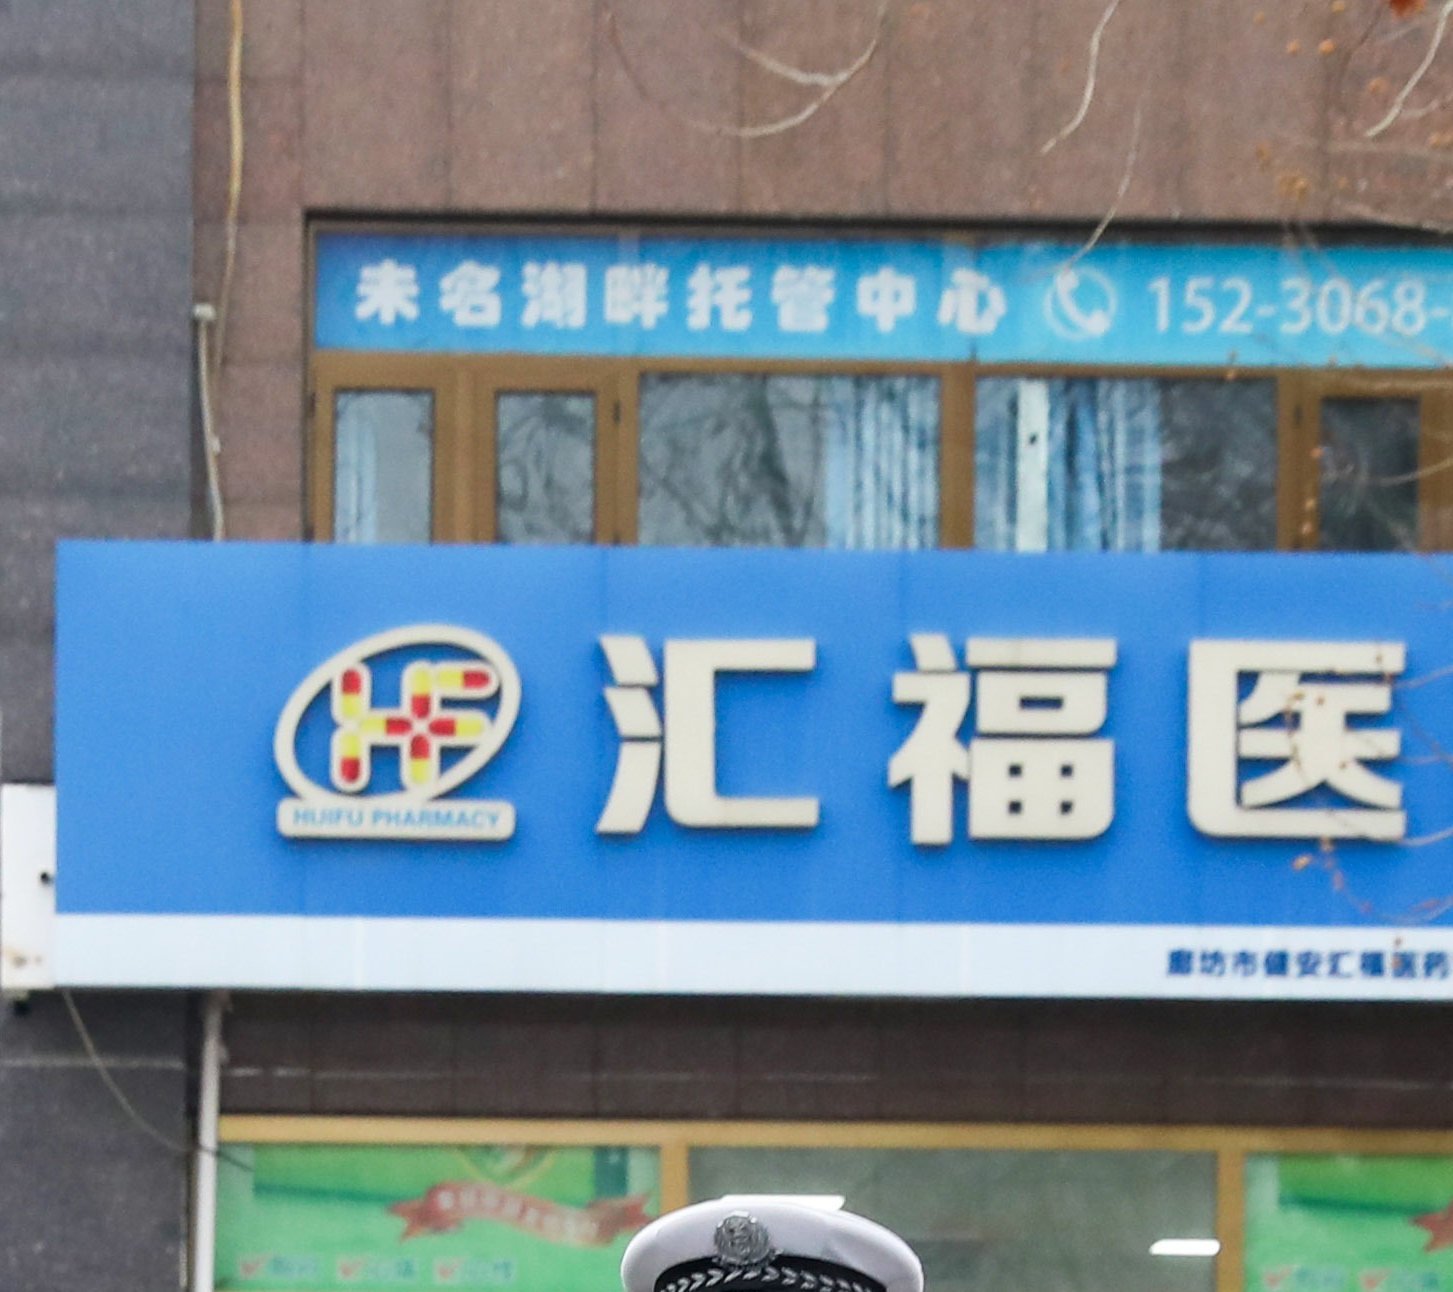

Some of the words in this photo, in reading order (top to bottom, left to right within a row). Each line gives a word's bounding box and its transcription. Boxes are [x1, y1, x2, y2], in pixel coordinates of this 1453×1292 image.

[355, 259, 1006, 335] 未名湖畔托管中心
